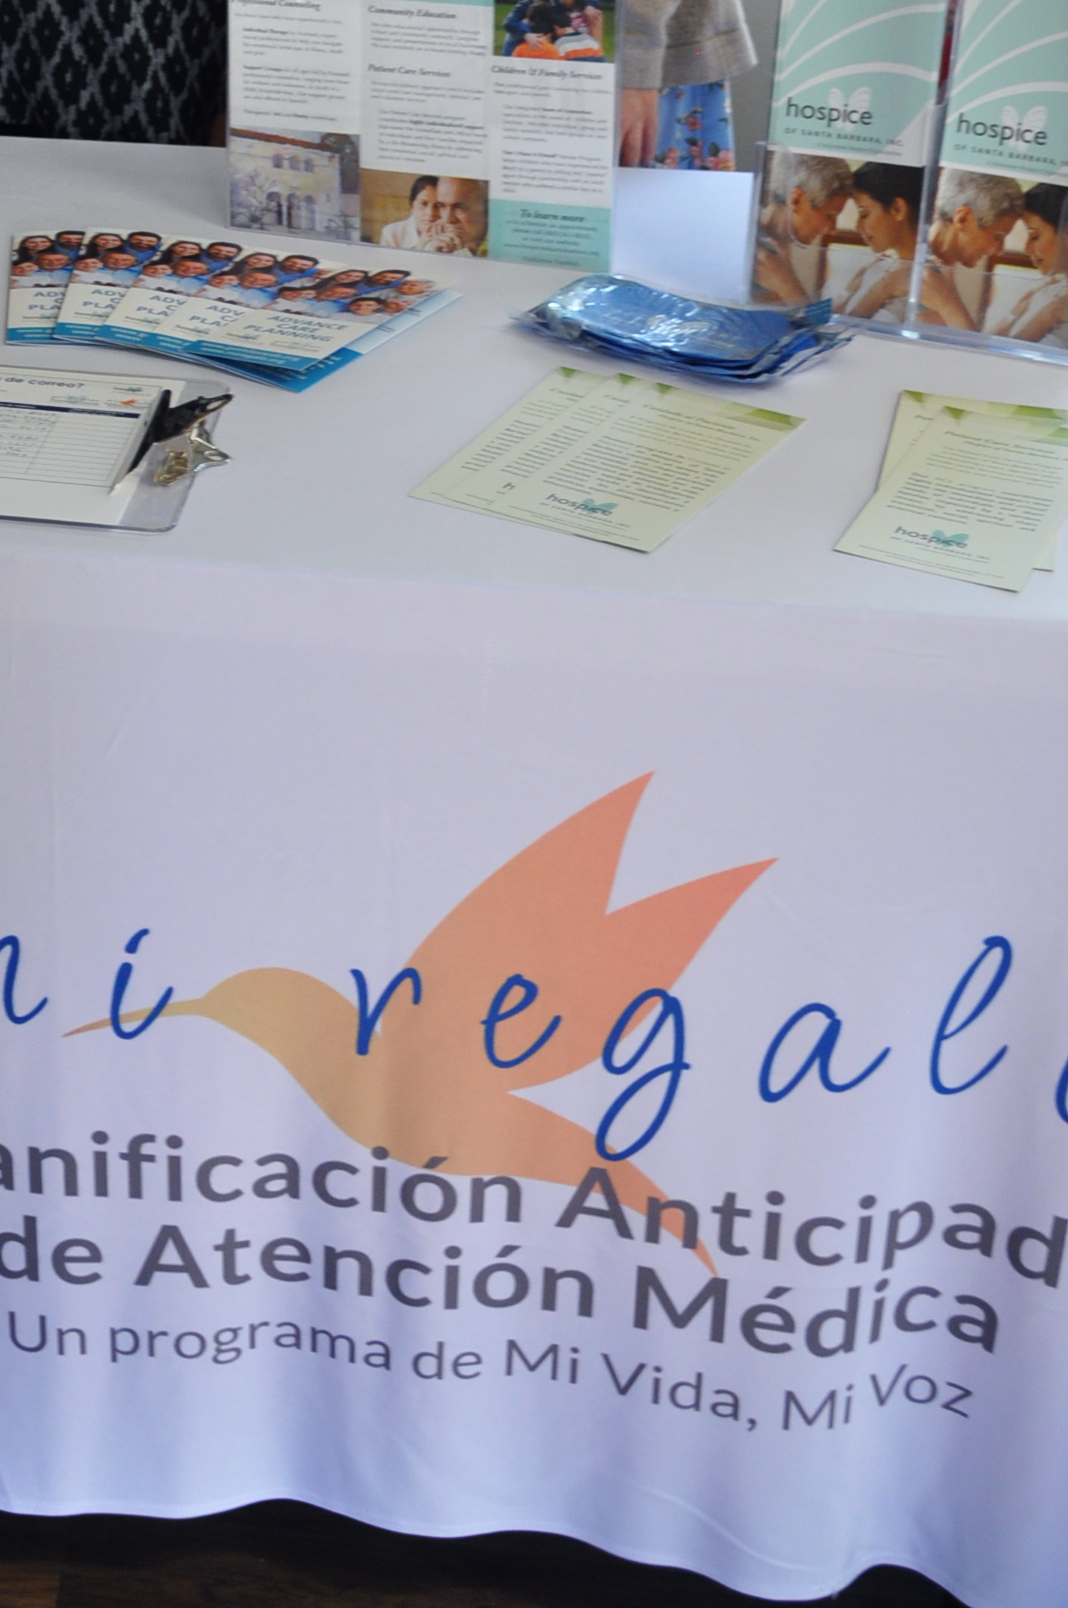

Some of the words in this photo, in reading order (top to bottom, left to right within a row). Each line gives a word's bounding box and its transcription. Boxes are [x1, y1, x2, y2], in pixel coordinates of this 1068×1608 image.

[368, 5, 414, 18] Community
[416, 9, 457, 19] Education
[367, 63, 396, 73] Patient
[398, 67, 417, 75] Care
[419, 68, 451, 78] Services
[491, 65, 526, 74] Children
[538, 69, 567, 80] Family
[569, 71, 602, 80] Services
[785, 97, 873, 127] hospice
[801, 129, 832, 138] SANTA
[956, 112, 1049, 146] hospice
[971, 147, 1004, 157] SANTA
[519, 208, 532, 218] To
[534, 211, 559, 220] learn
[561, 215, 586, 223] more
[266, 314, 349, 331] ADVANCE
[276, 322, 321, 333] CARE
[242, 324, 334, 342] PLANNING
[4, 375, 25, 384] de
[28, 378, 85, 389] correo?
[545, 493, 613, 517] hospice
[893, 525, 969, 550] hospice
[133, 1224, 596, 1320] Atención
[633, 1265, 1000, 1359] Médica
[8, 1311, 88, 1357] Un
[109, 1319, 392, 1372] programa
[412, 1341, 484, 1380] de
[505, 1338, 580, 1385] Mi
[601, 1352, 759, 1432] Vida,
[781, 1382, 855, 1432] Mi
[869, 1363, 974, 1419] Voz
